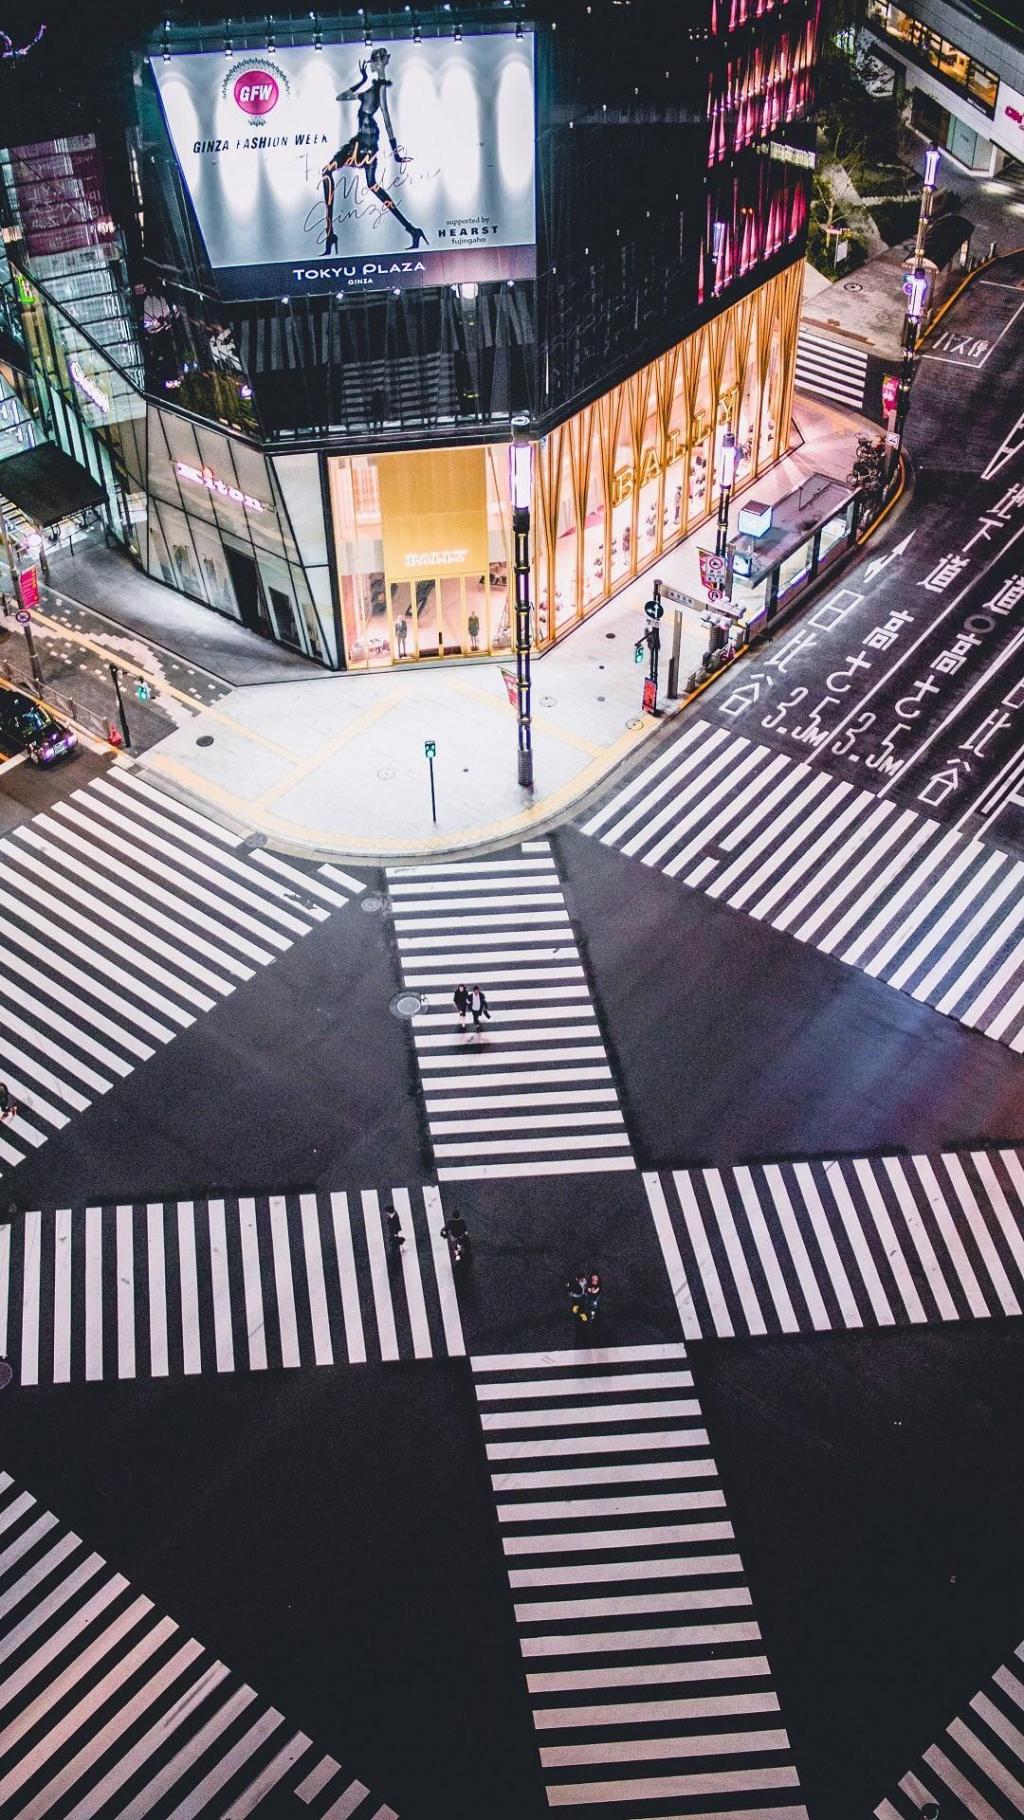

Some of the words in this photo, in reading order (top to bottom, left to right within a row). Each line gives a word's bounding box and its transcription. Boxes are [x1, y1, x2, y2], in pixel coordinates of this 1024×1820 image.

[239, 84, 274, 103] GFW
[192, 139, 230, 154] GINZA
[236, 136, 289, 150] FASHION
[300, 141, 411, 181] Fnding
[303, 199, 402, 245] Ginza
[438, 225, 499, 238] HEARST
[445, 217, 480, 227] supported
[481, 216, 490, 224] by
[292, 266, 356, 281] TOKYU
[362, 261, 427, 276] PLAZA
[347, 278, 374, 286] GINZA
[612, 384, 739, 508] BALLY
[761, 686, 841, 747] 3.5M
[831, 712, 912, 777] 3.5M
